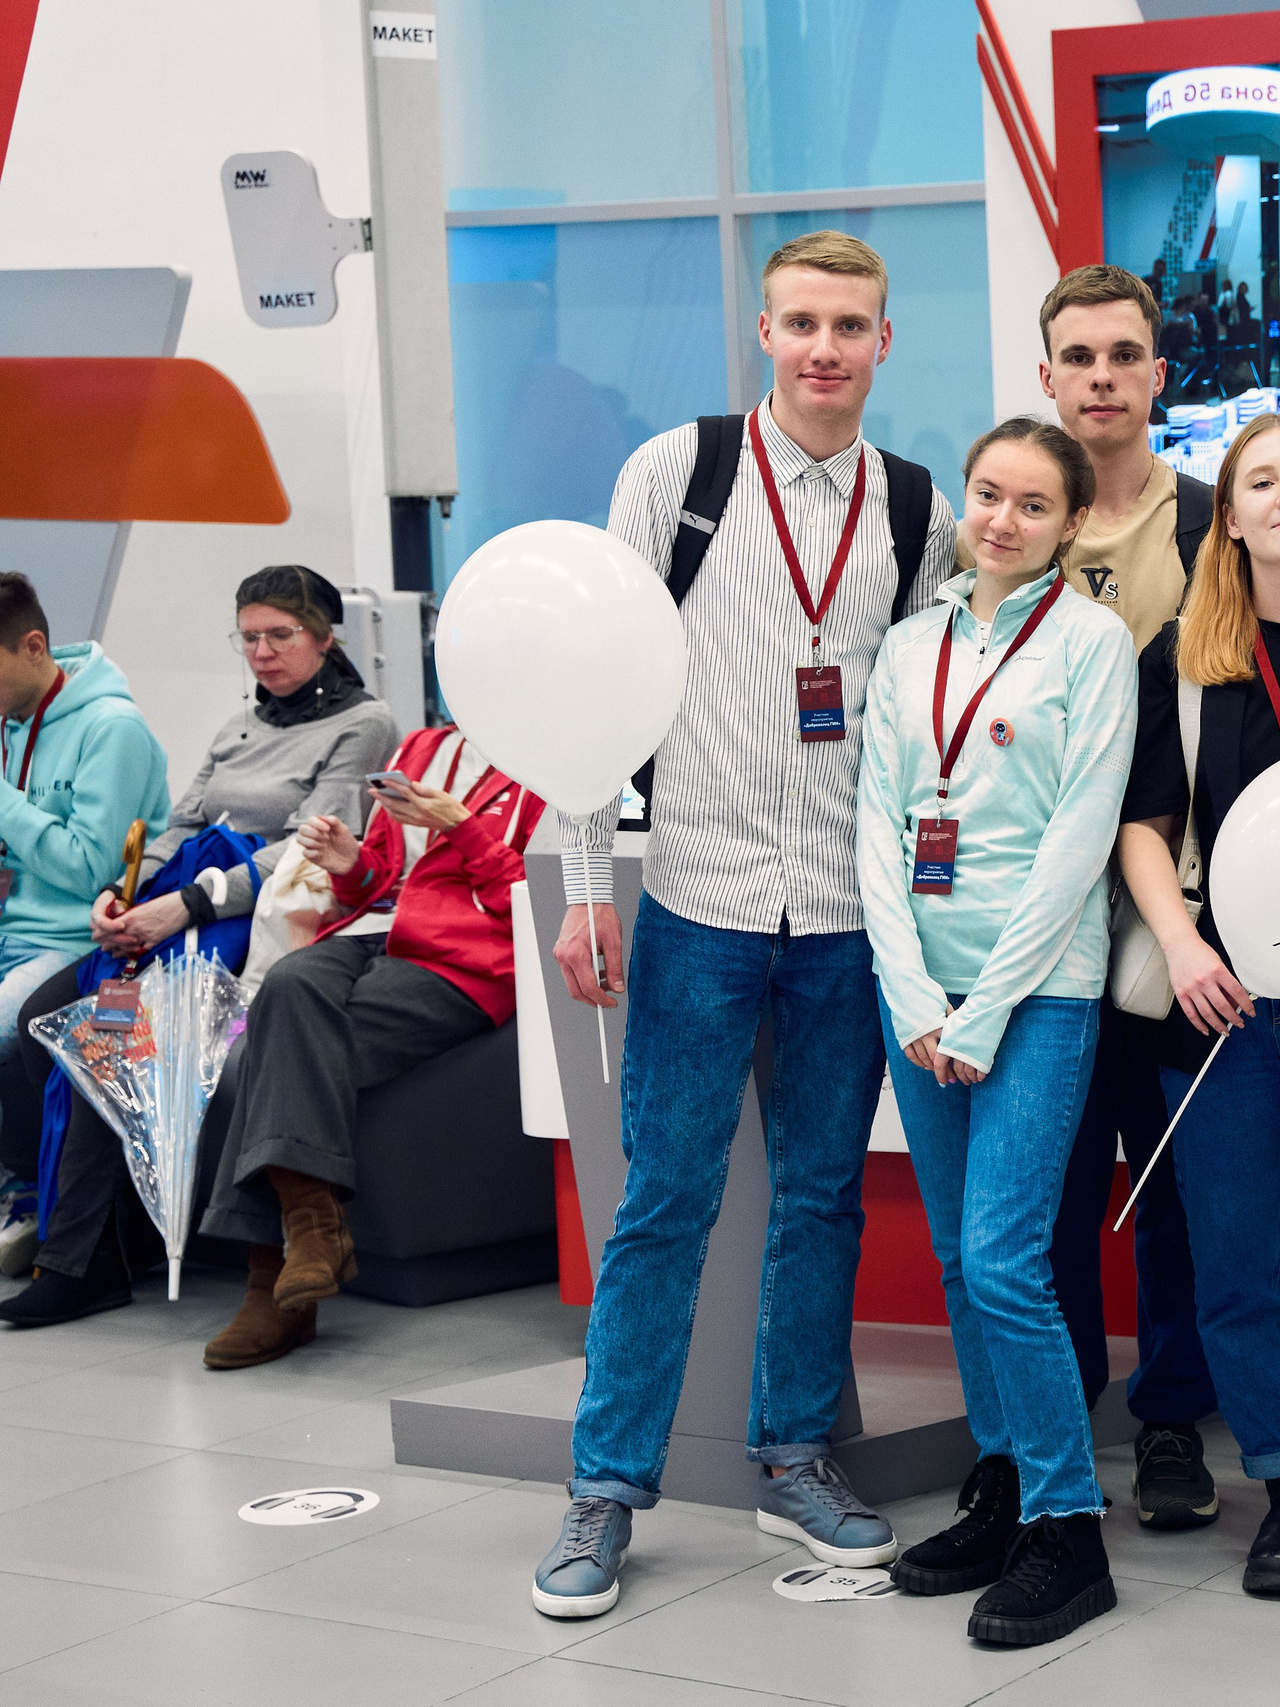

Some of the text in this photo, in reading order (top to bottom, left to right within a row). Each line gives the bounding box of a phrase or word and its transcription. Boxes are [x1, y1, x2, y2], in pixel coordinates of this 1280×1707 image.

[373, 26, 433, 43] МАКЕТ
[259, 291, 315, 309] МАКЕТ
[830, 1577, 860, 1585] 35
